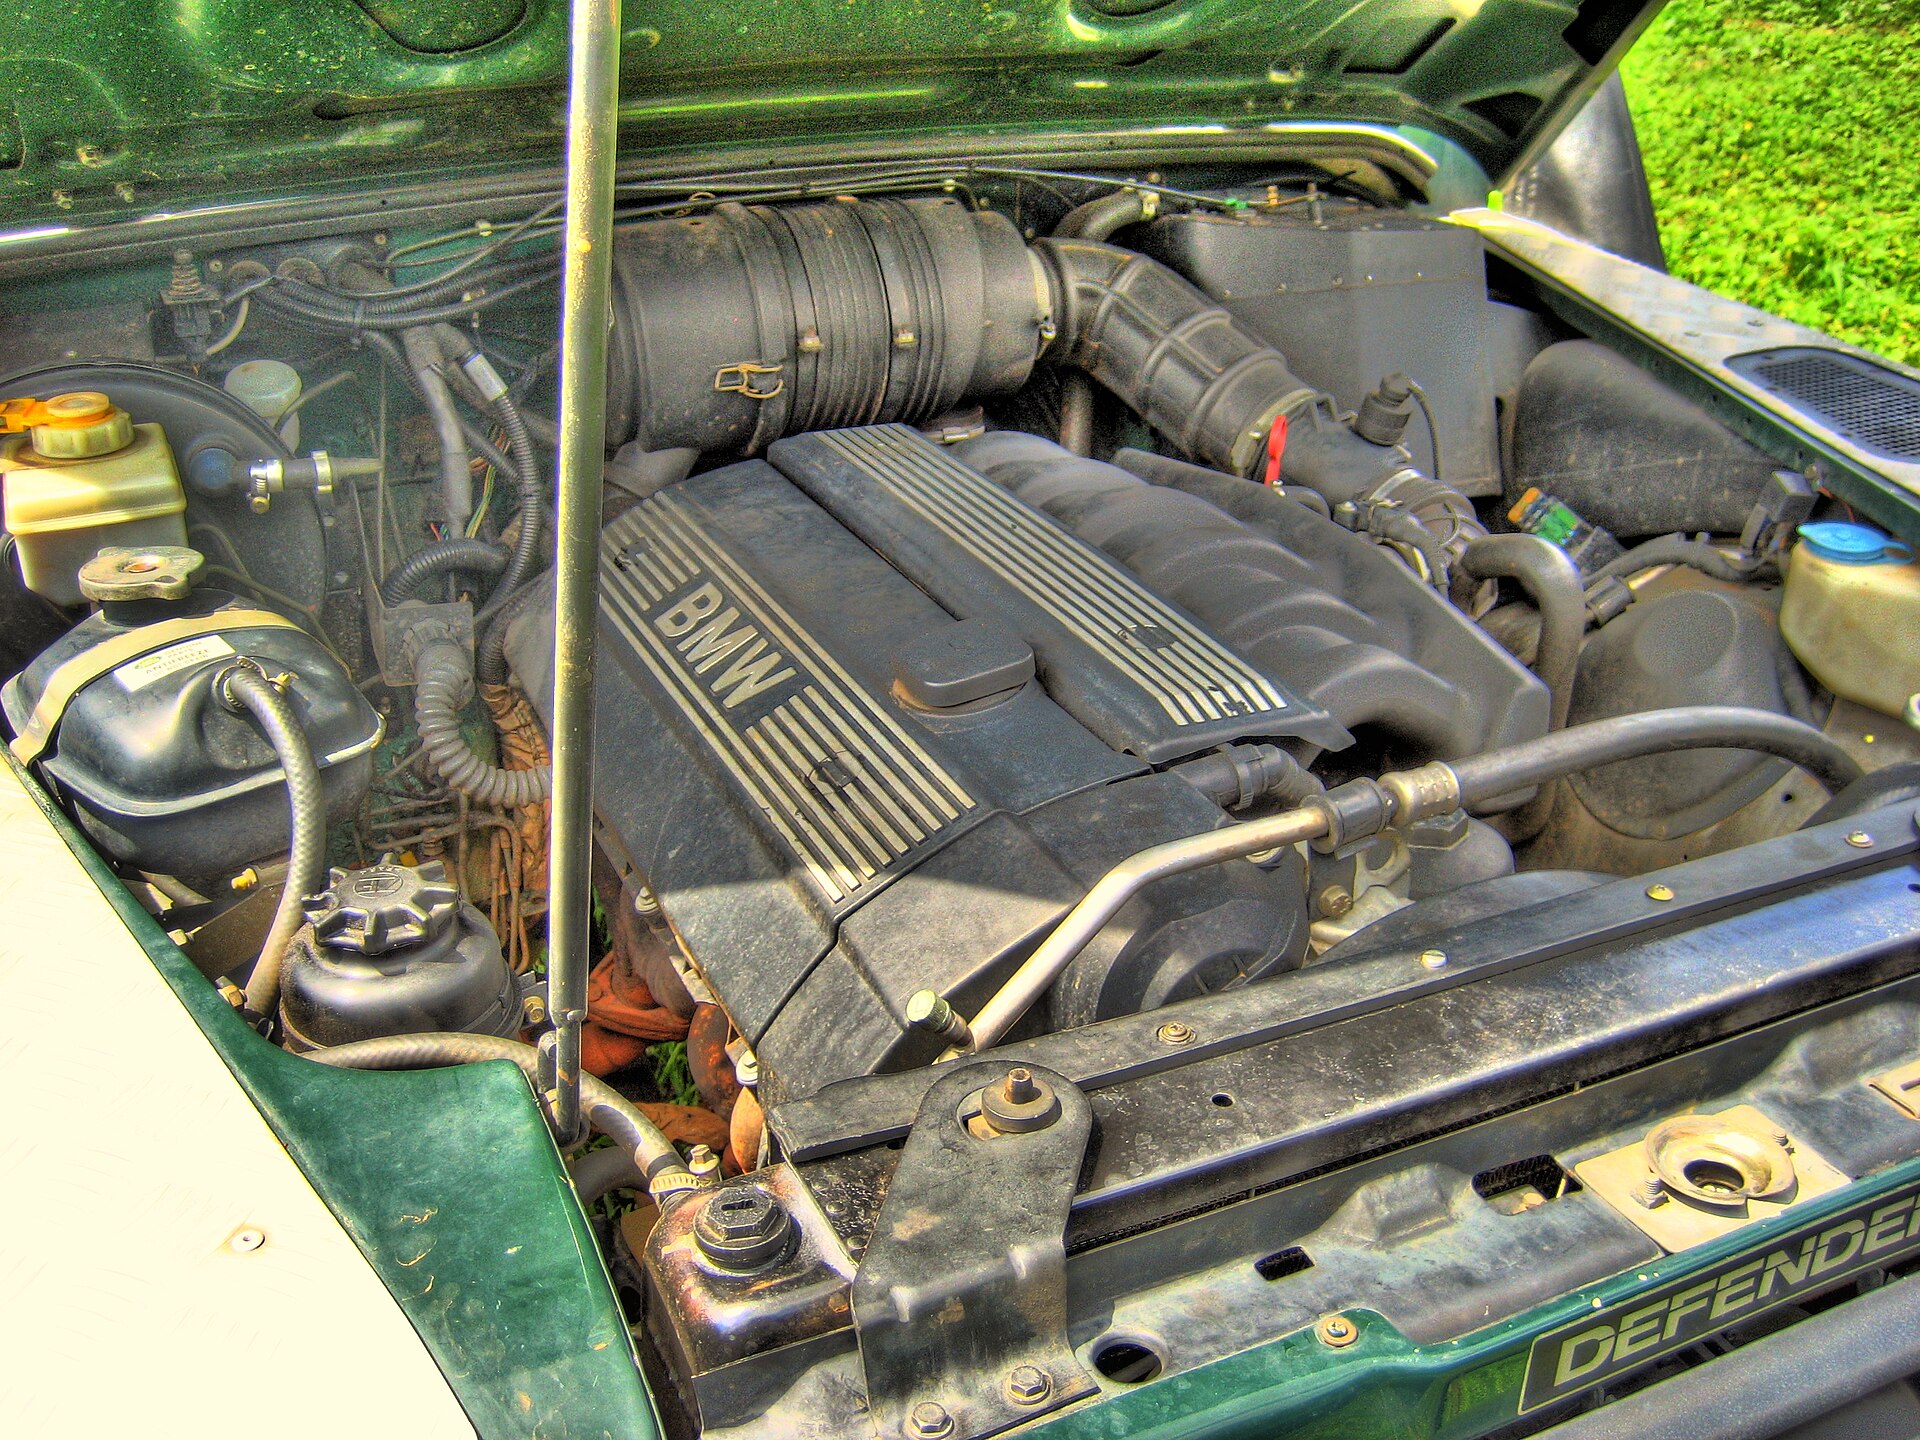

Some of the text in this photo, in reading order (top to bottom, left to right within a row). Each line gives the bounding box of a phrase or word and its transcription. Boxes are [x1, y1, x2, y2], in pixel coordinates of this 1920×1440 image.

[145, 649, 210, 675] ANTIFREEZE
[654, 582, 798, 709] BMW
[1554, 1188, 1920, 1387] DEFENDE
